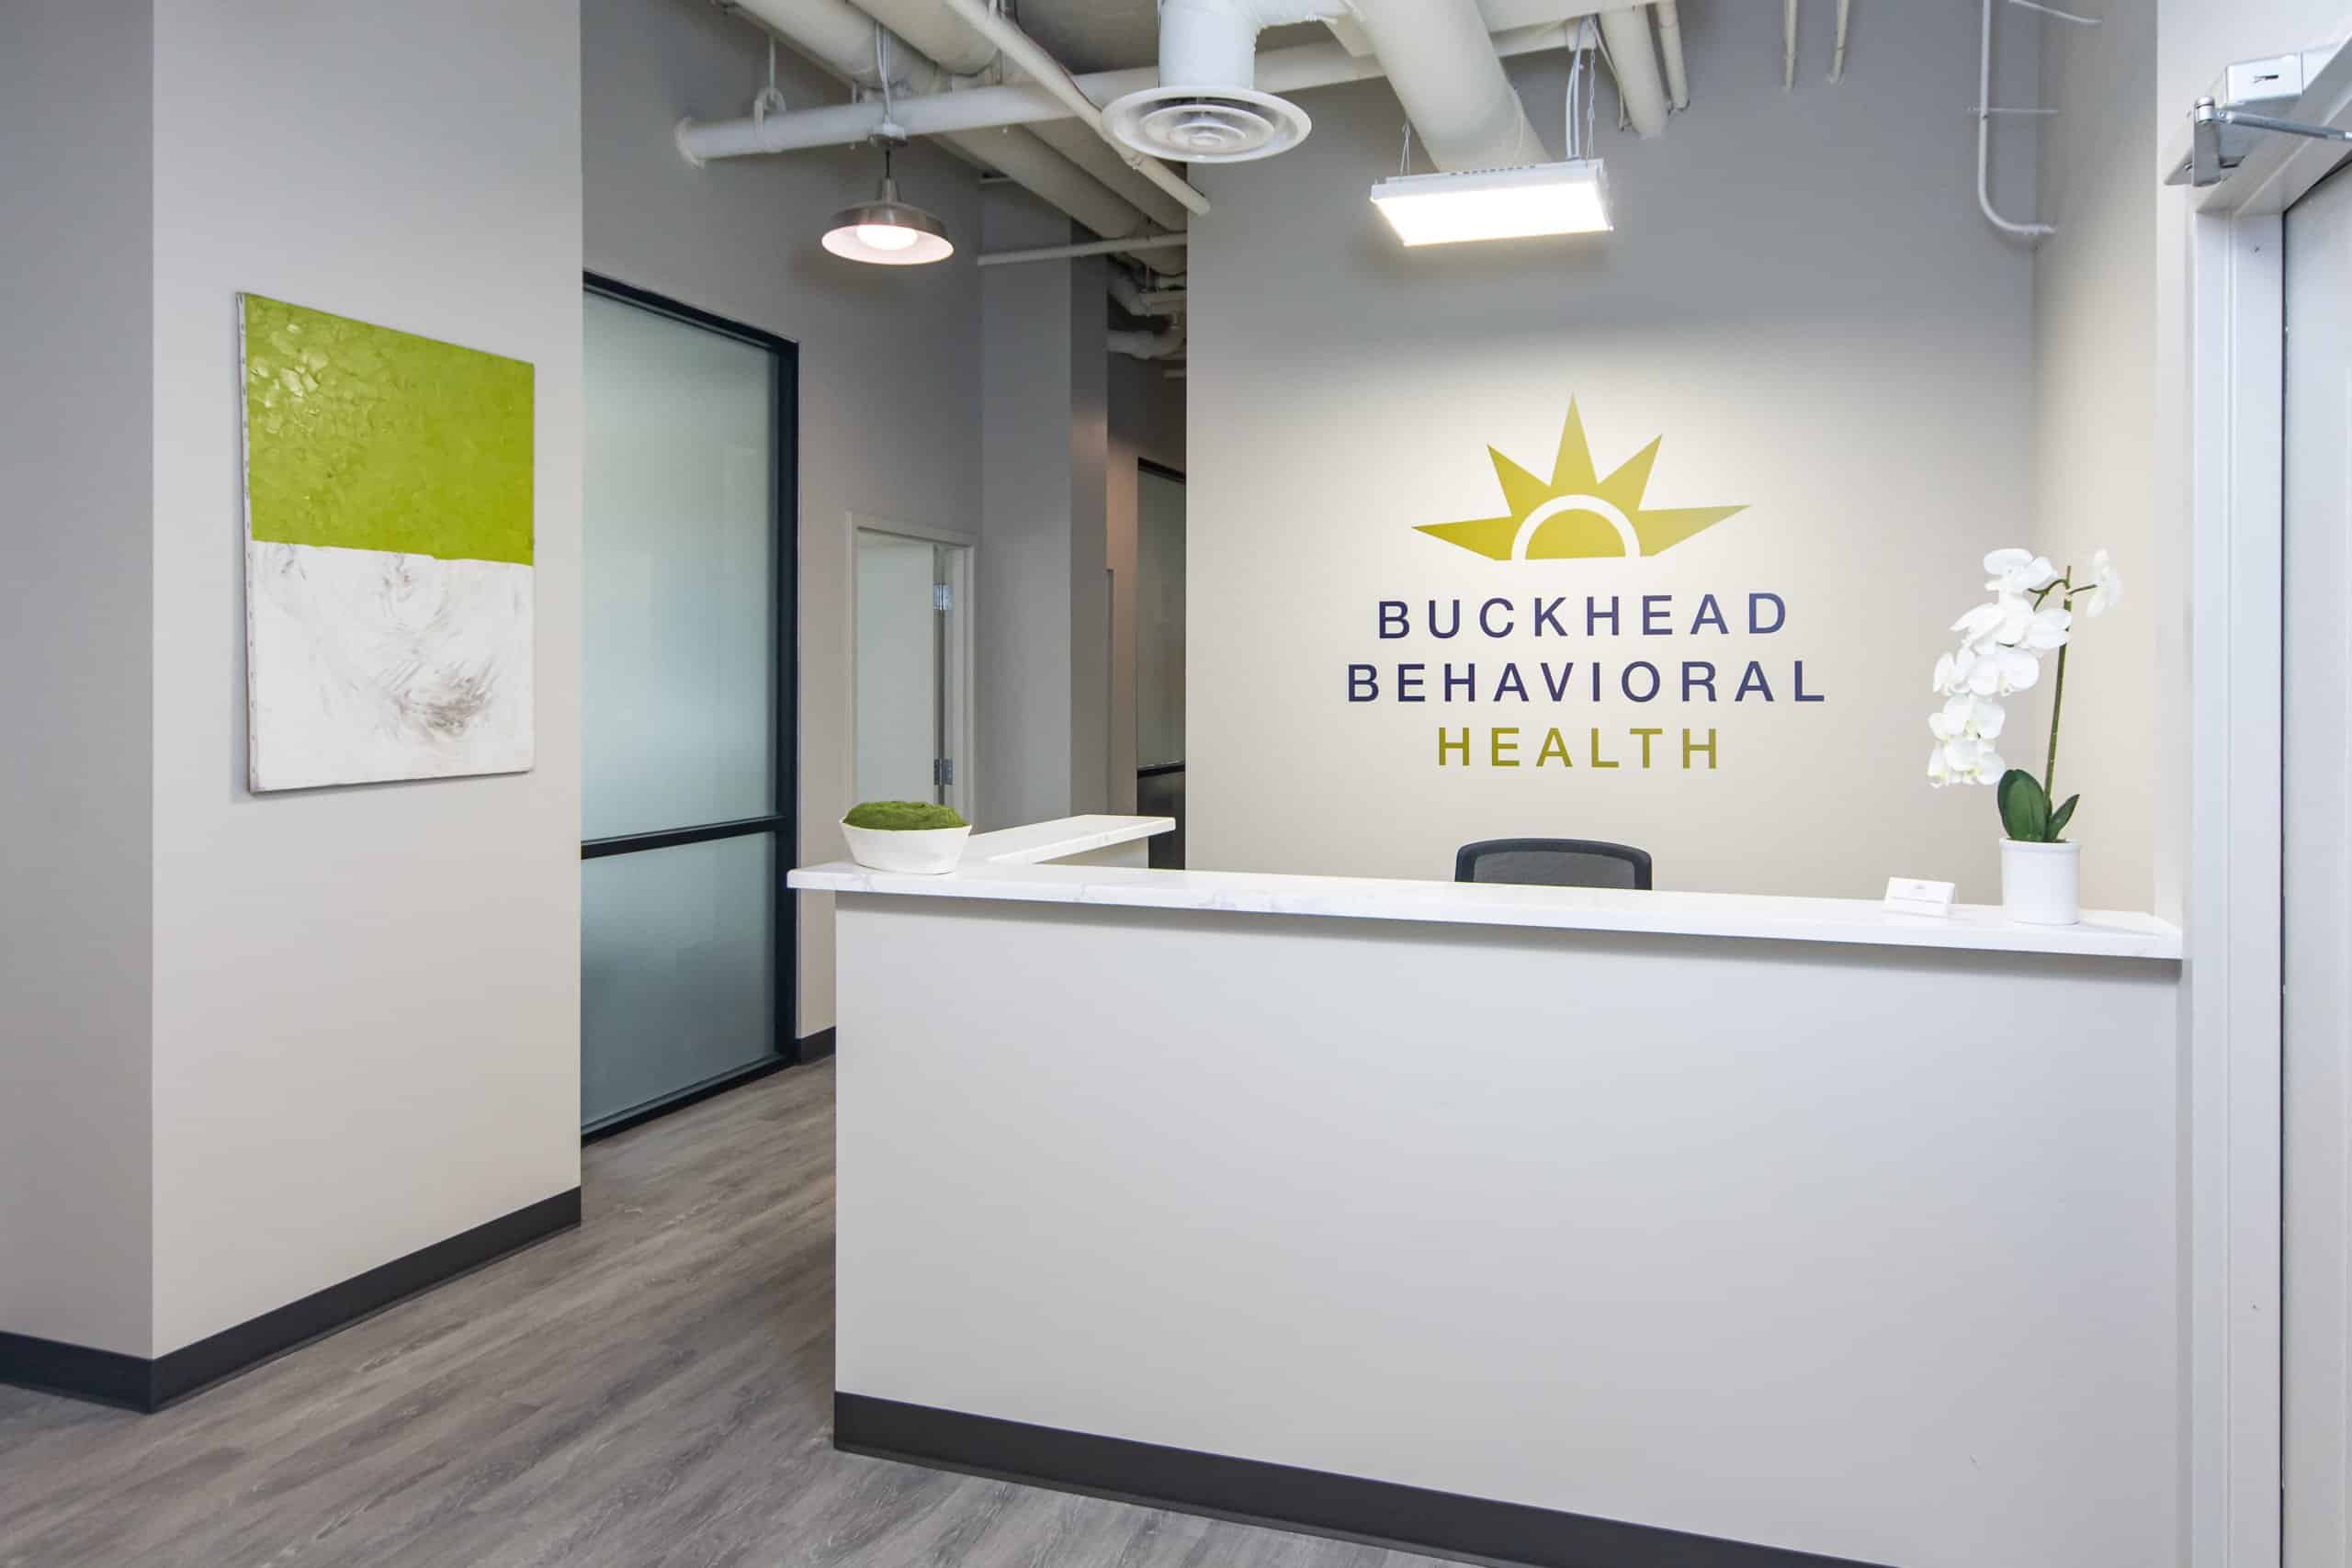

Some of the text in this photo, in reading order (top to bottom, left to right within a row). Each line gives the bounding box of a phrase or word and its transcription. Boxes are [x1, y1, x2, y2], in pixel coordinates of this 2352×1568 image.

[1378, 592, 1786, 639] BUCKHEAD
[1347, 660, 1826, 703] BEHAVIORAL
[1438, 726, 1717, 770] HEALTH
